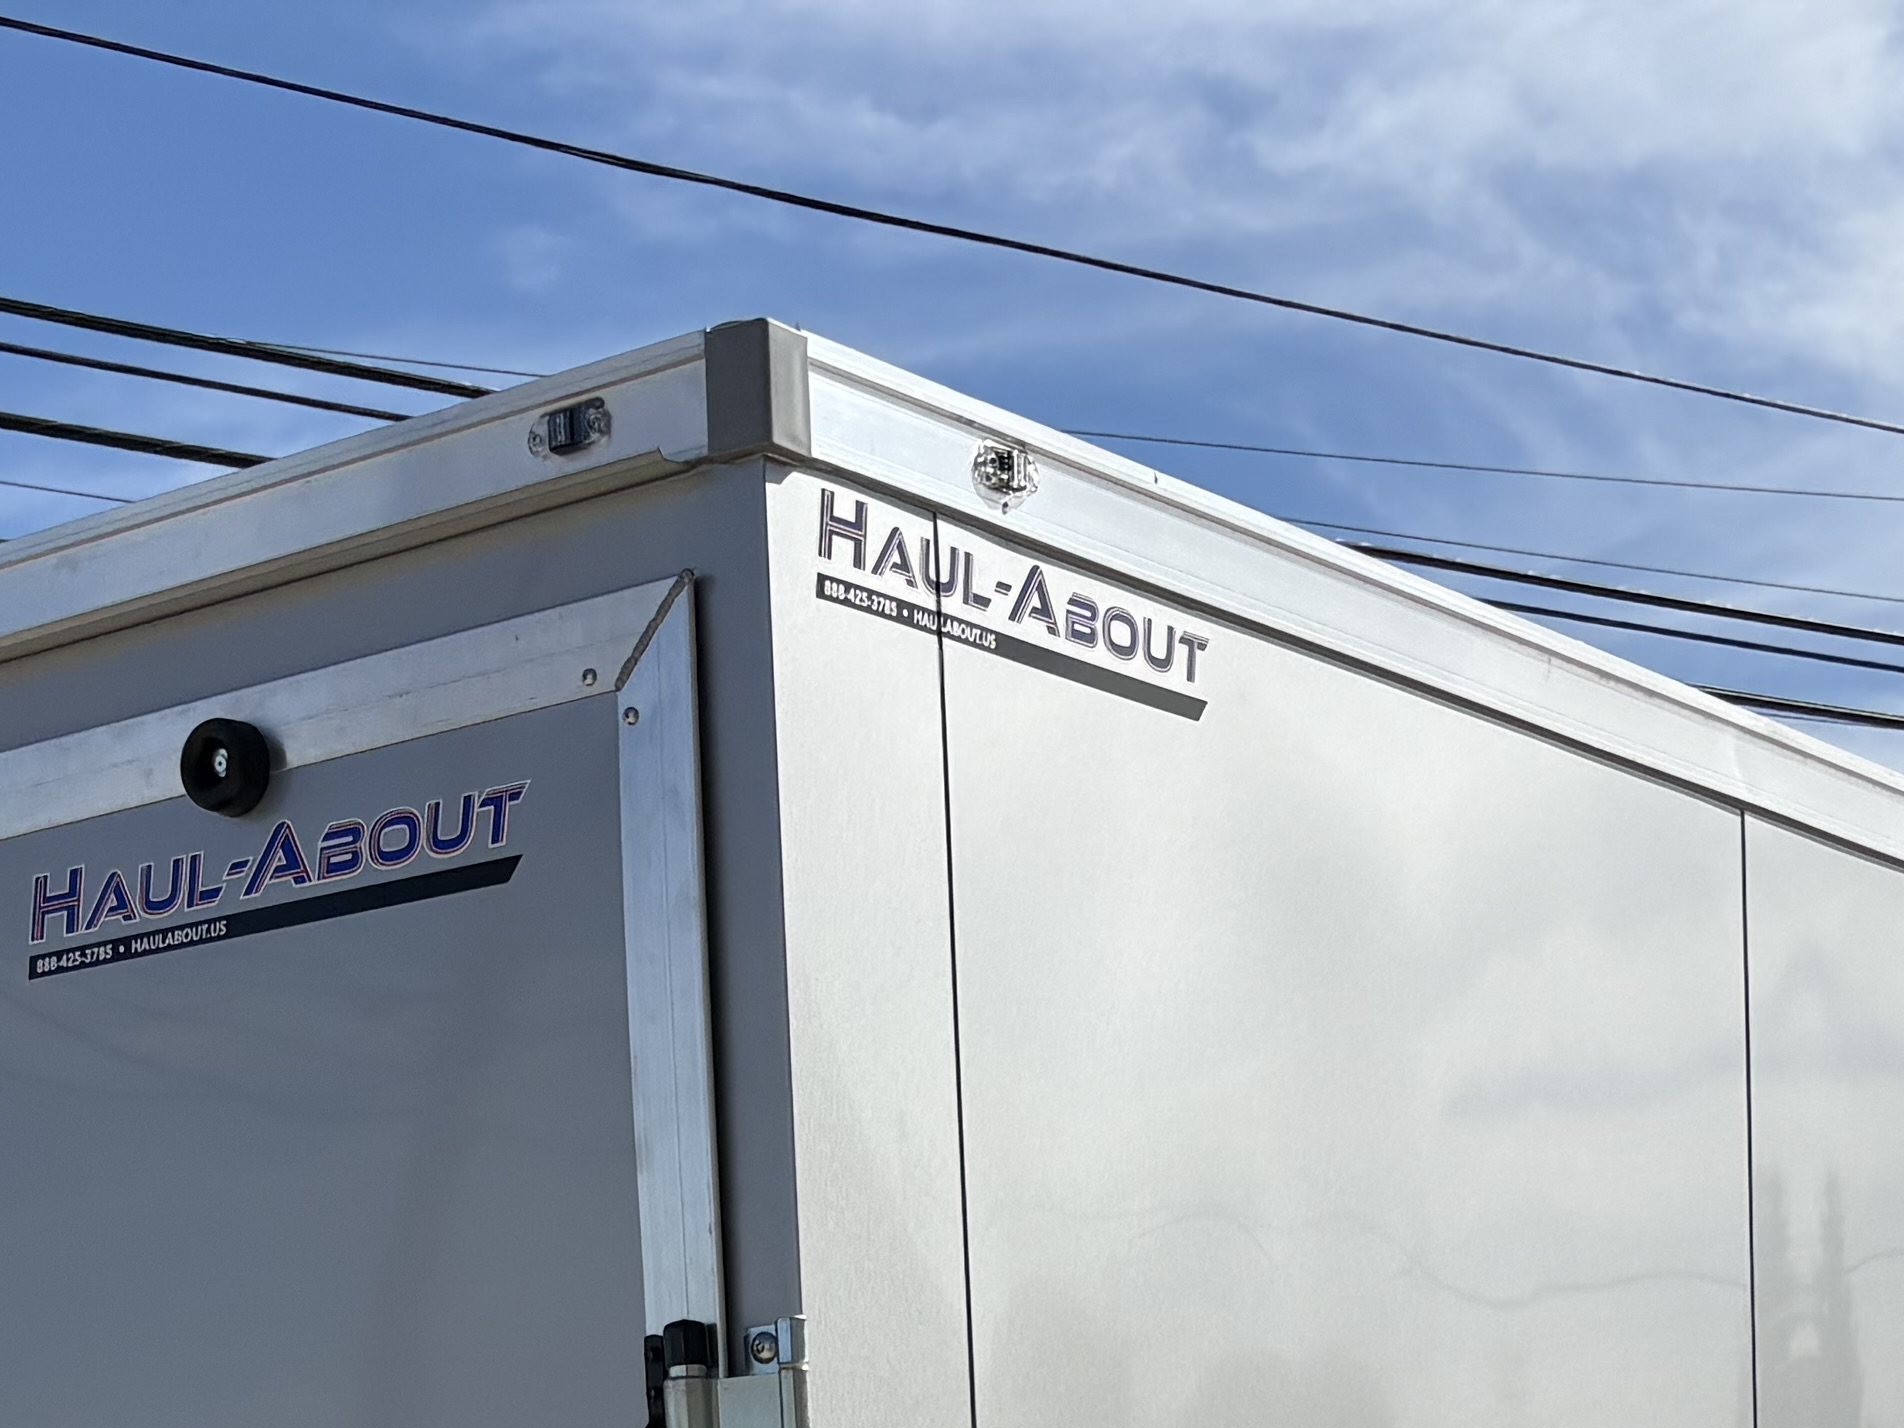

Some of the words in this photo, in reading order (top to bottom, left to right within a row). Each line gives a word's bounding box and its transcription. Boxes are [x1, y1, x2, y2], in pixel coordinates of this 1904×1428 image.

[817, 487, 1210, 684] HAUL-ABOUT
[28, 780, 532, 944] HAUL-ABOUT
[130, 920, 228, 954] HAULABOUT.US
